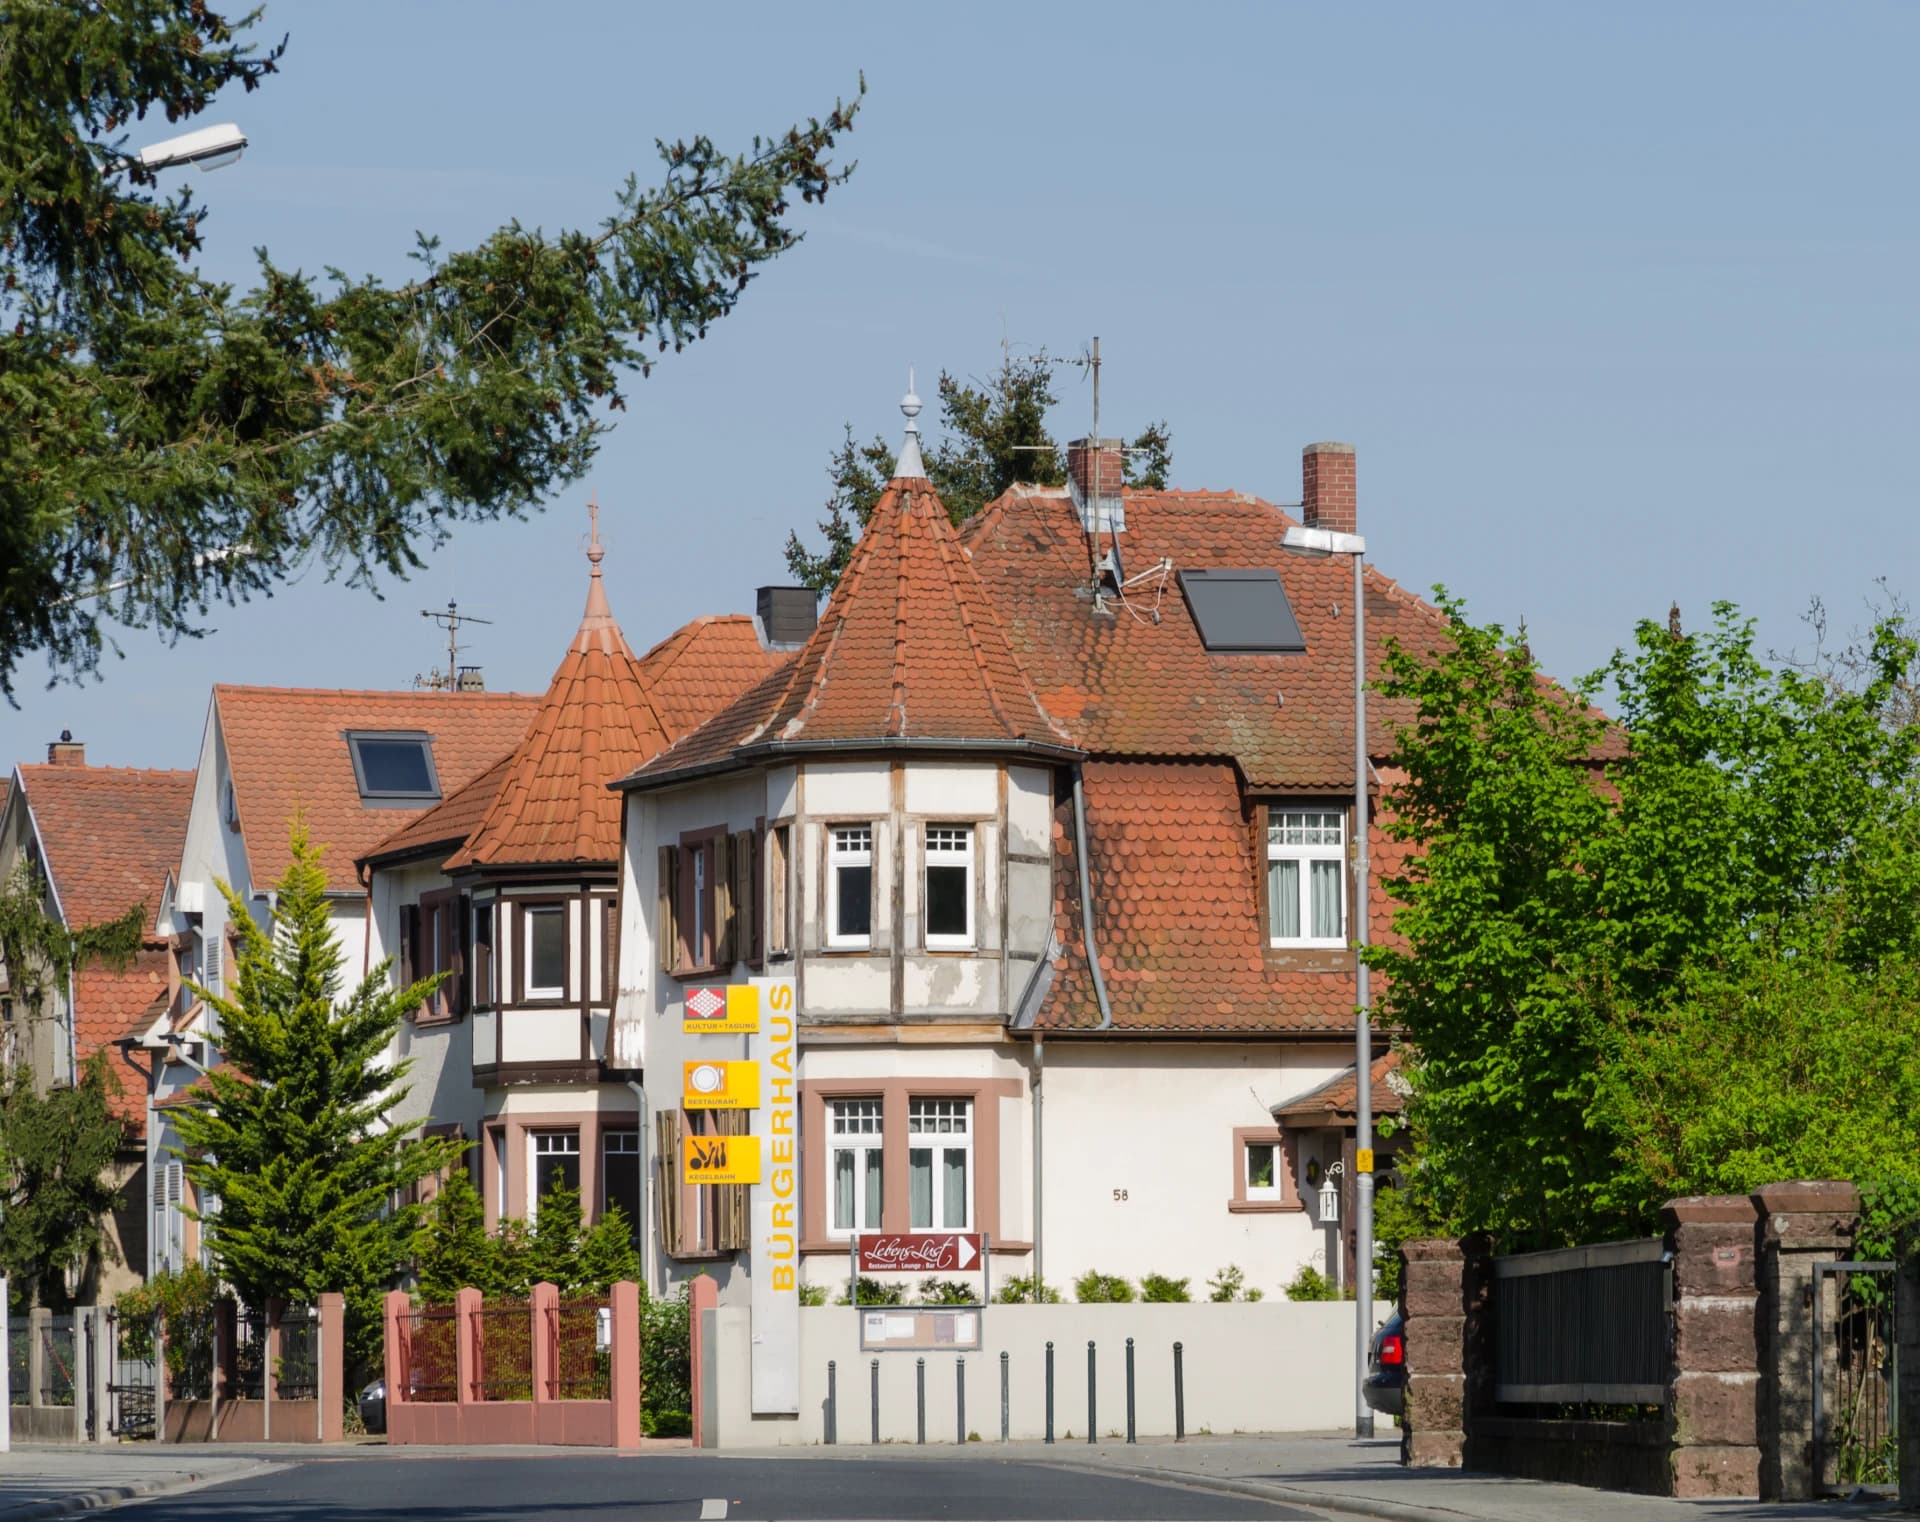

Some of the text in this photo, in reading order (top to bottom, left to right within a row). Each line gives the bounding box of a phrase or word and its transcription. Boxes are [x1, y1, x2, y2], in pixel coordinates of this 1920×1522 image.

[767, 984, 794, 1291] BÜRGERHAUS
[1113, 1189, 1128, 1201] 58
[901, 1262, 922, 1270] Lounge
